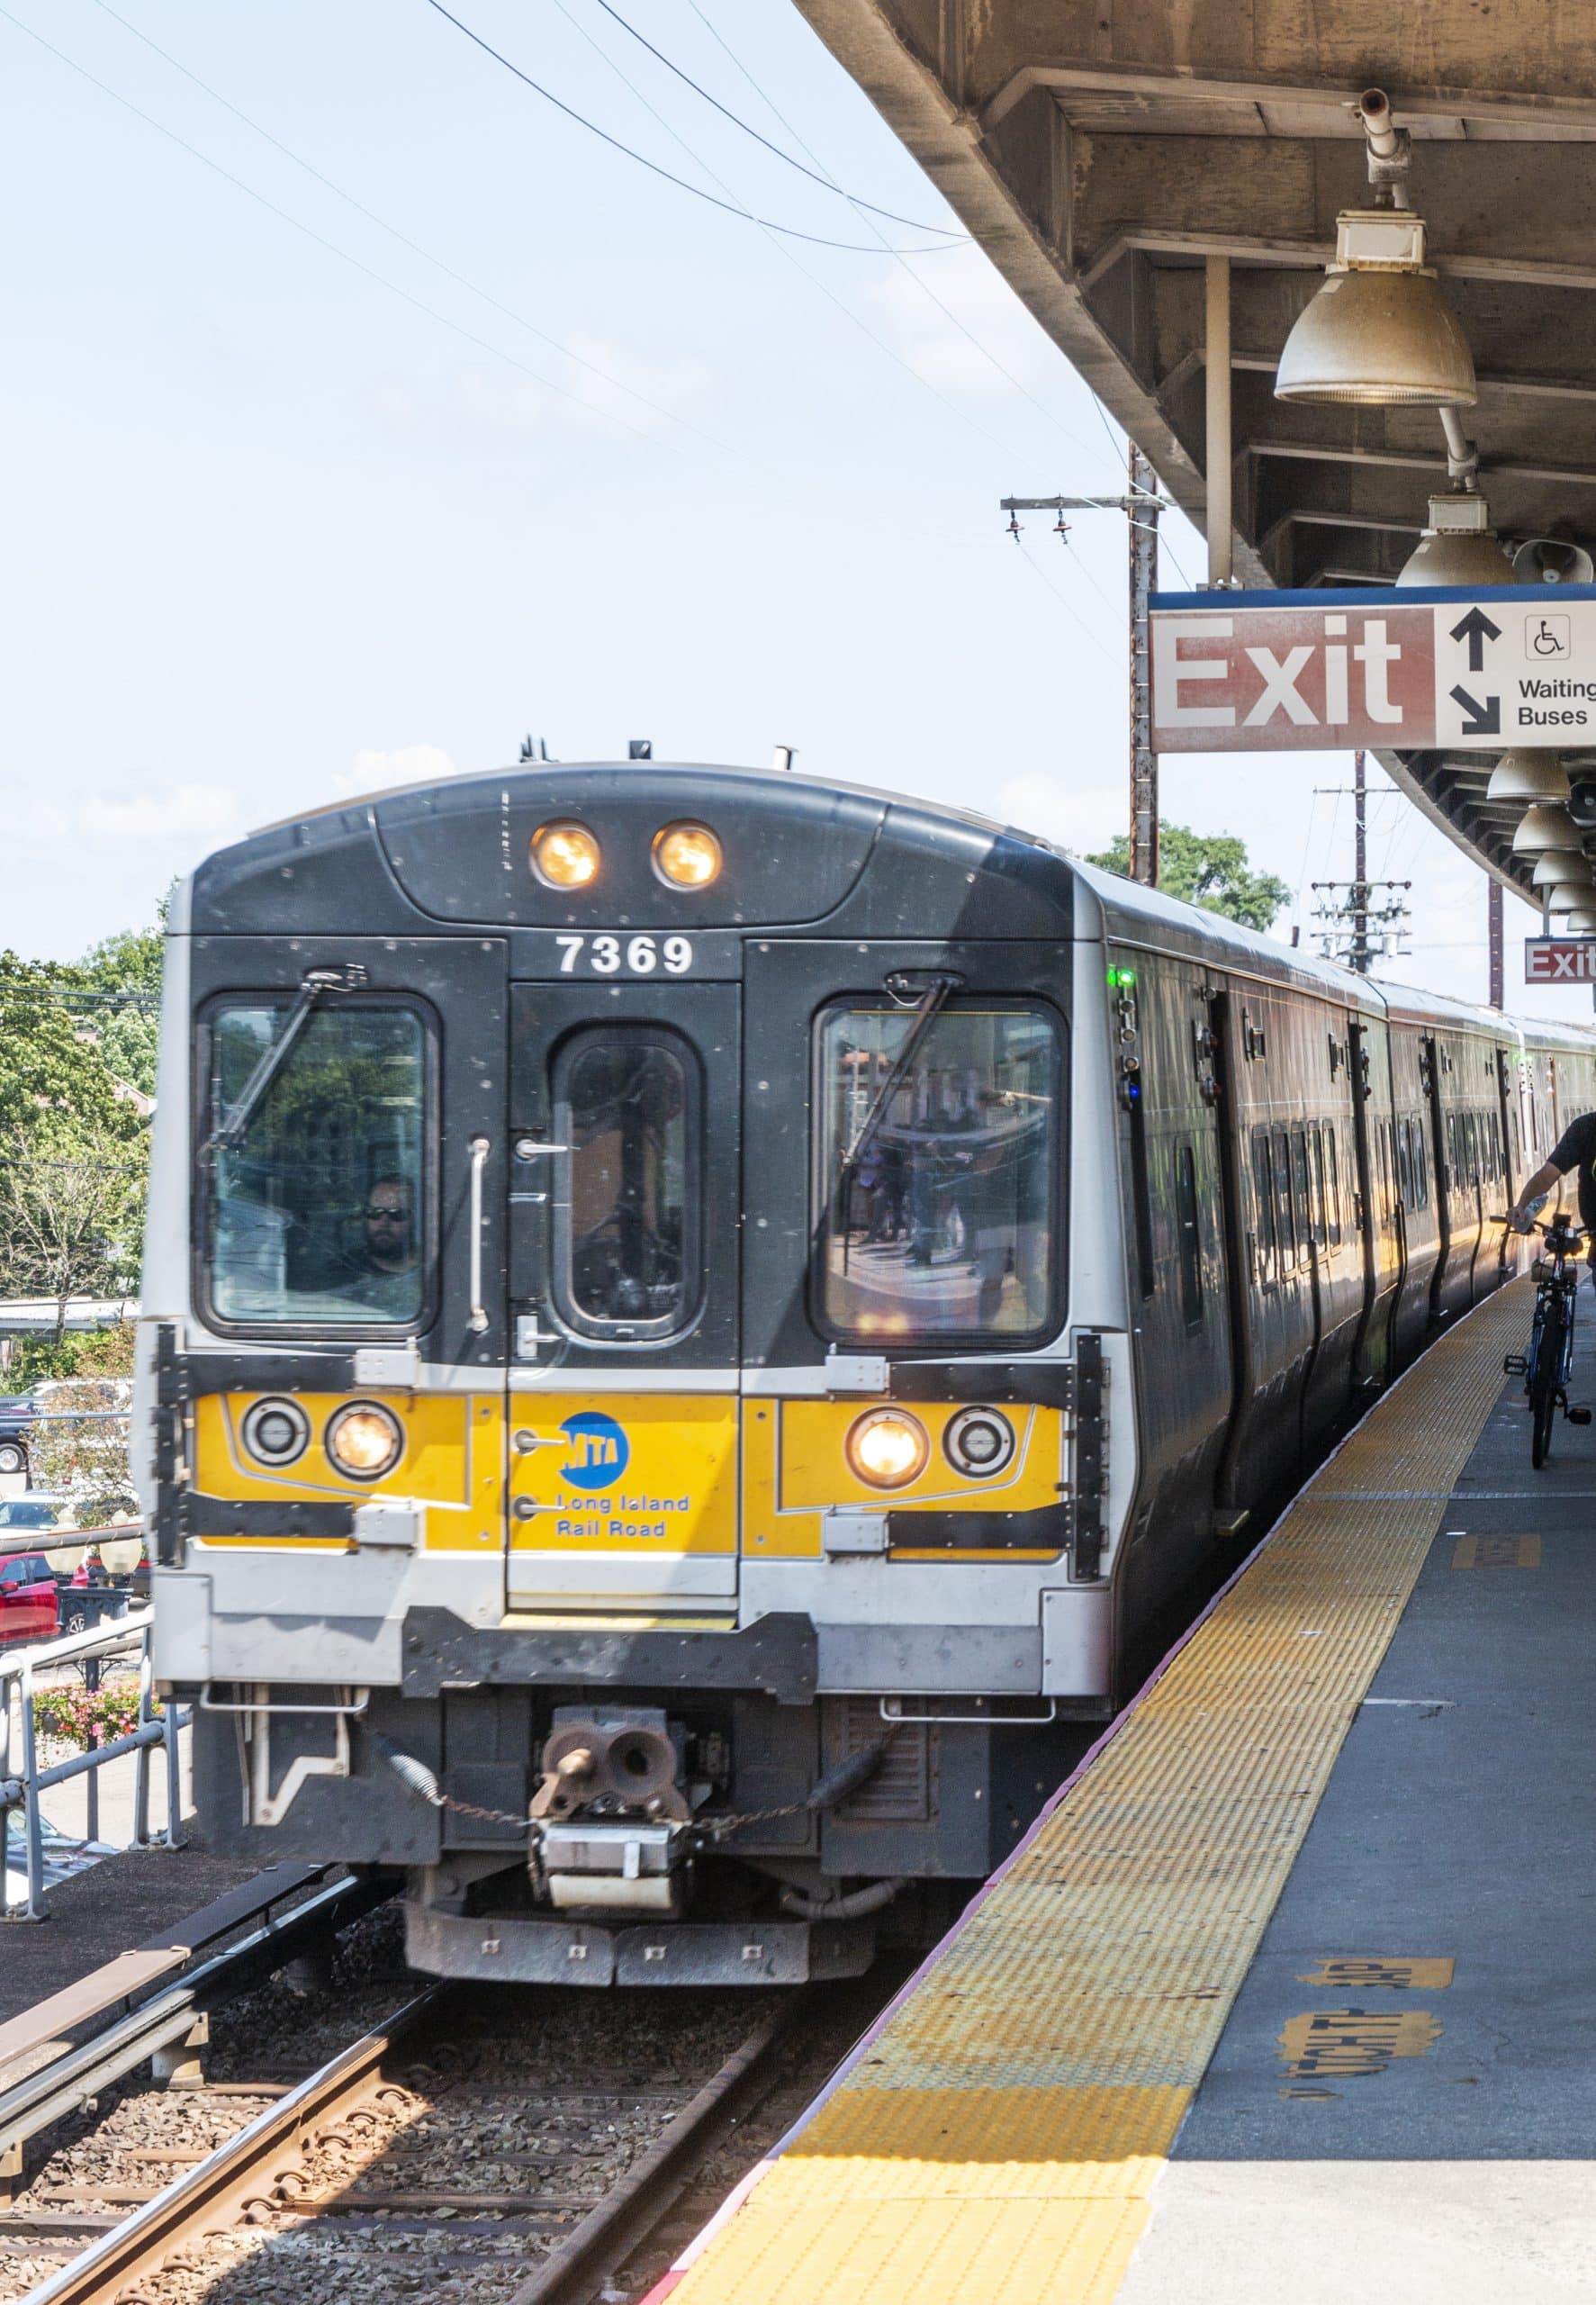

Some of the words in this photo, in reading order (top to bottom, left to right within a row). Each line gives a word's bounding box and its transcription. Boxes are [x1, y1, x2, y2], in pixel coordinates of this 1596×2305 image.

[1152, 615, 1403, 728] Exit
[1519, 679, 1596, 701] Waiting
[1519, 707, 1588, 726] Buses
[555, 936, 692, 973] 7369
[1527, 944, 1596, 978] Exit
[559, 1429, 618, 1469] MTA
[556, 1495, 611, 1514] Long
[621, 1496, 690, 1511] Island
[556, 1521, 600, 1536] Rail
[609, 1521, 665, 1536] Road
